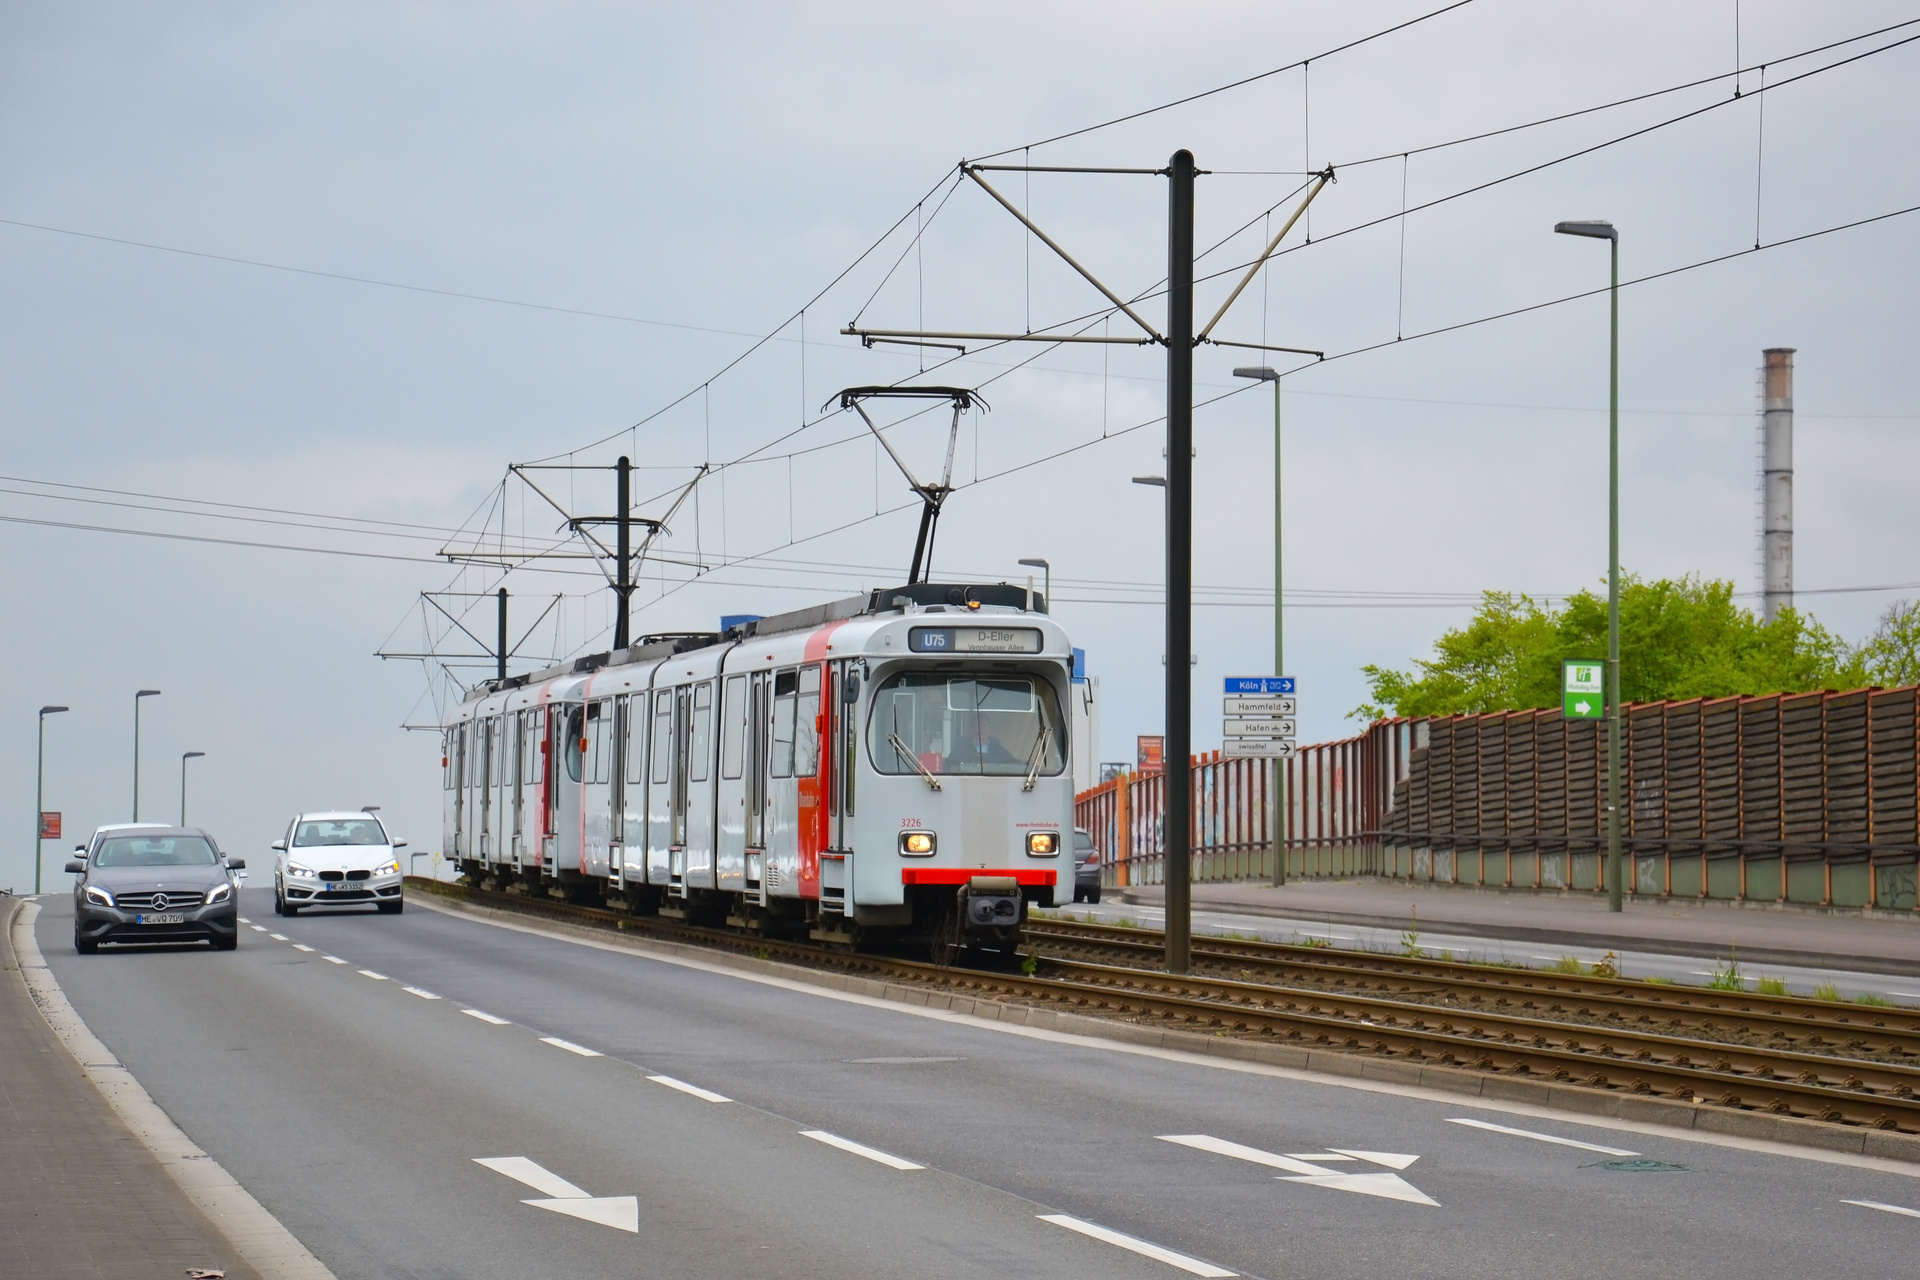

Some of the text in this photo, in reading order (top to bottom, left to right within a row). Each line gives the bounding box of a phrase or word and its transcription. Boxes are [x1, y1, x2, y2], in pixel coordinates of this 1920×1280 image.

[924, 634, 945, 647] U75
[978, 631, 1014, 642] D-Eller
[968, 643, 1006, 651] Vennhauser
[1239, 681, 1259, 690] Köln
[1238, 702, 1281, 711] Hammfeld
[1245, 724, 1270, 732] Hafen
[900, 818, 922, 827] 3226
[141, 915, 152, 923] ME
[168, 914, 183, 922] 709
